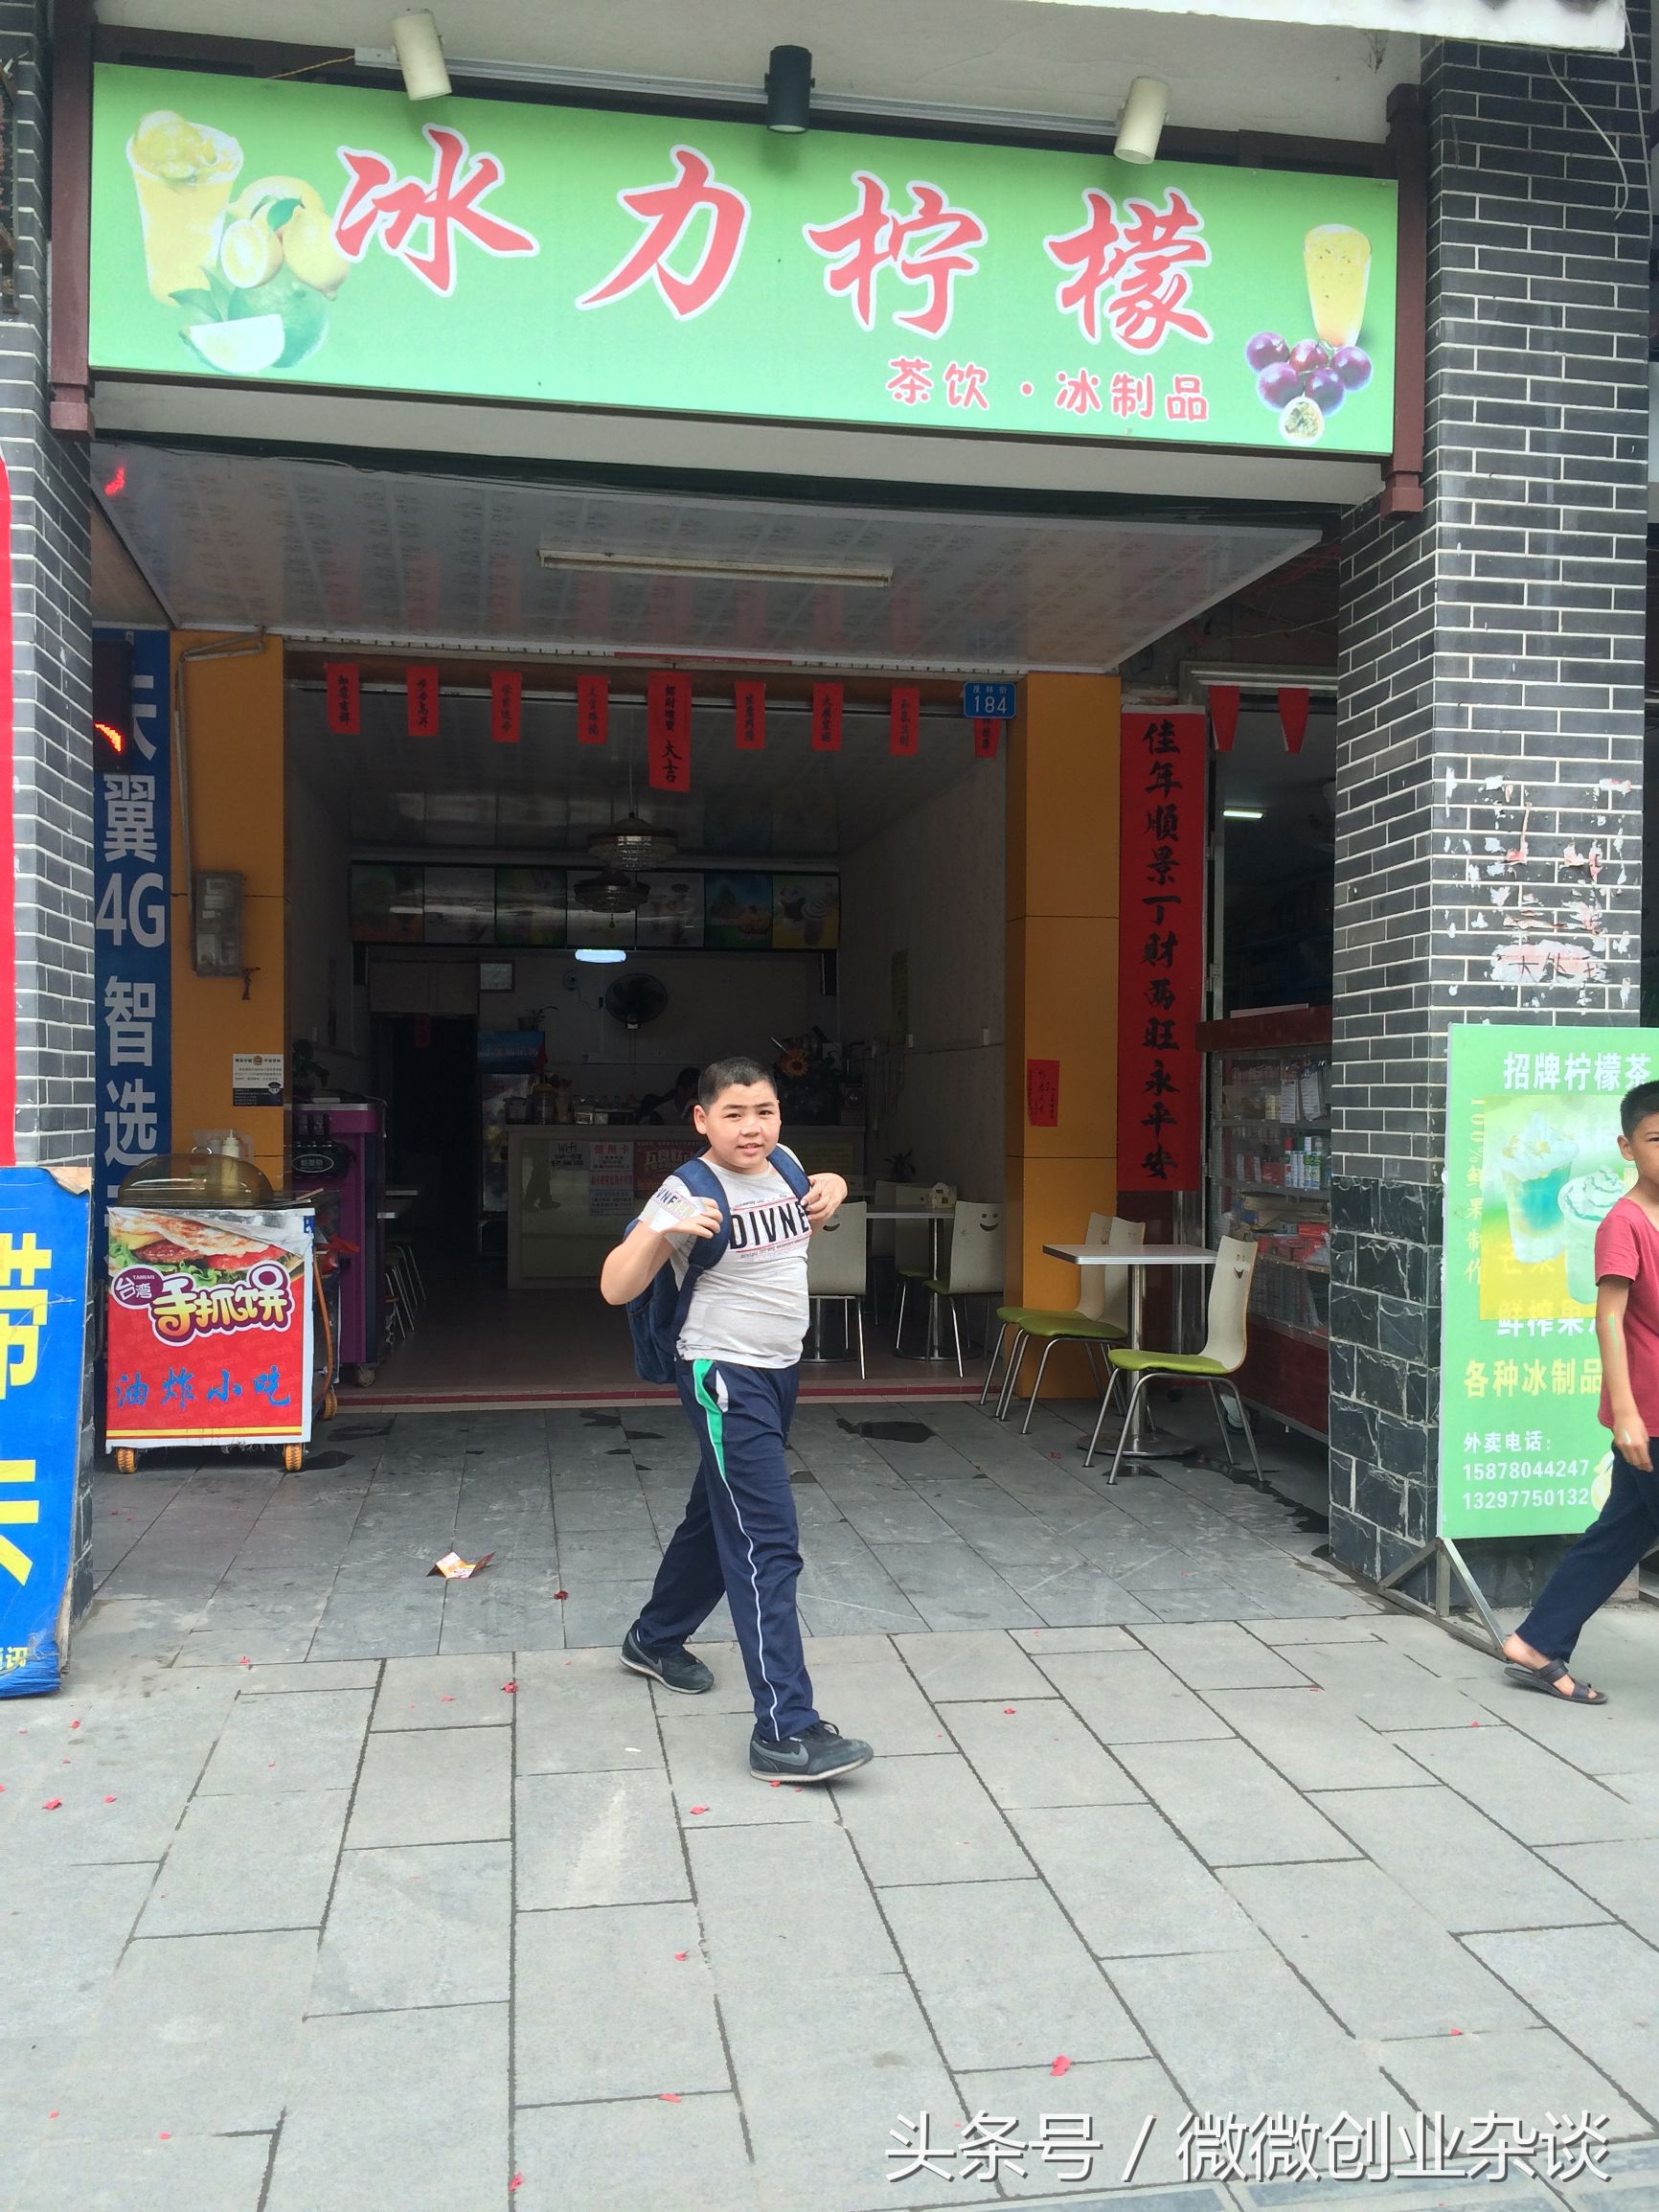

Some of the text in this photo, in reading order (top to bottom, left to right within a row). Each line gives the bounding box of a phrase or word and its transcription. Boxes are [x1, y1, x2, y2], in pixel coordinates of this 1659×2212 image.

[332, 123, 1214, 354] 冰力柠檬
[974, 696, 1008, 714] 184
[115, 1277, 152, 1301] 台湾
[152, 1266, 288, 1338] 手抓饼
[116, 1364, 291, 1410] 油炸小吃
[1463, 1357, 1603, 1398] 各种冰制品
[1463, 1459, 1590, 1481] 15878044247
[1463, 1488, 1589, 1510] 13297750132
